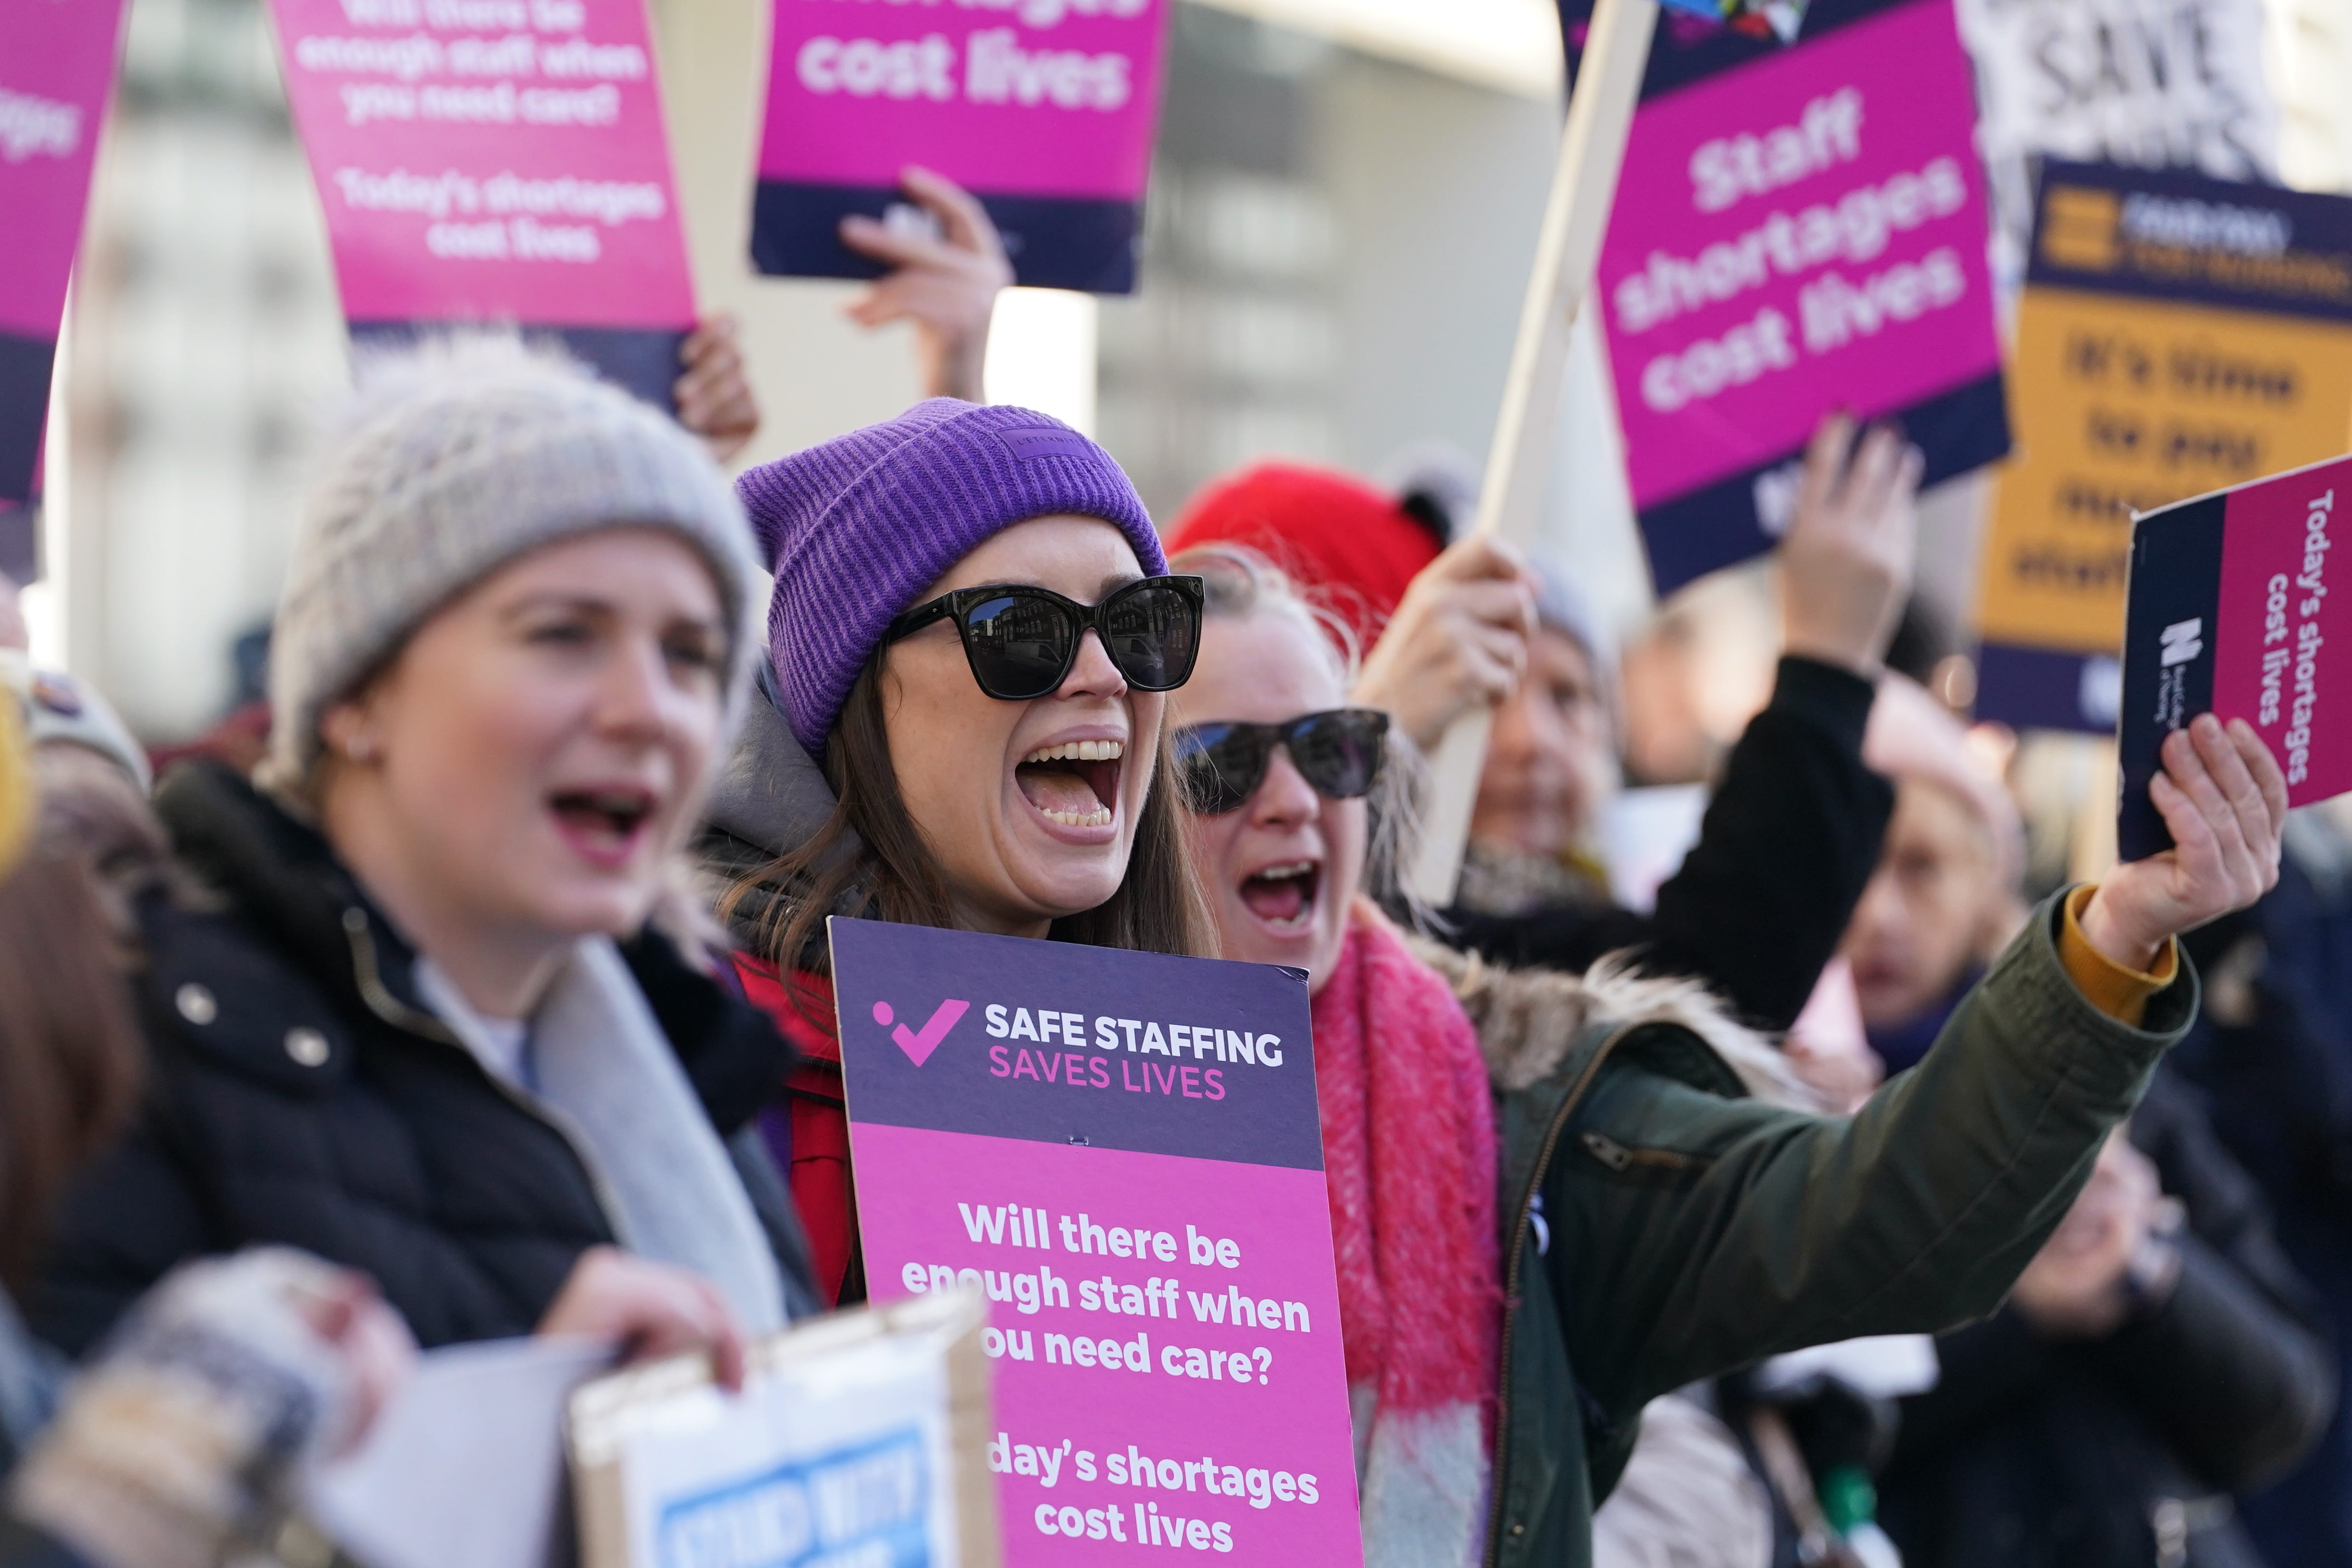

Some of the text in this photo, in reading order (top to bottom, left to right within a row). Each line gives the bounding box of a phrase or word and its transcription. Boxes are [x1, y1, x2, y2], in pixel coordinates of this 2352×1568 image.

[797, 29, 1130, 110] cost lives
[1691, 89, 1862, 211] Staff
[1617, 158, 1965, 332] shortages
[1643, 249, 1964, 411] cost lives
[2259, 574, 2290, 726] cost lives
[2281, 490, 2333, 789] Today's shortages
[986, 1004, 1283, 1067] SAFE STAFFING
[990, 1046, 1225, 1100] SAVES LIVES
[958, 1203, 1240, 1268] Will there be
[1079, 1276, 1179, 1319] staff
[1187, 1285, 1310, 1332] when
[980, 1327, 1272, 1385] ou need care?
[986, 1432, 1319, 1509] day's shortages
[1035, 1502, 1233, 1552] cost lives
